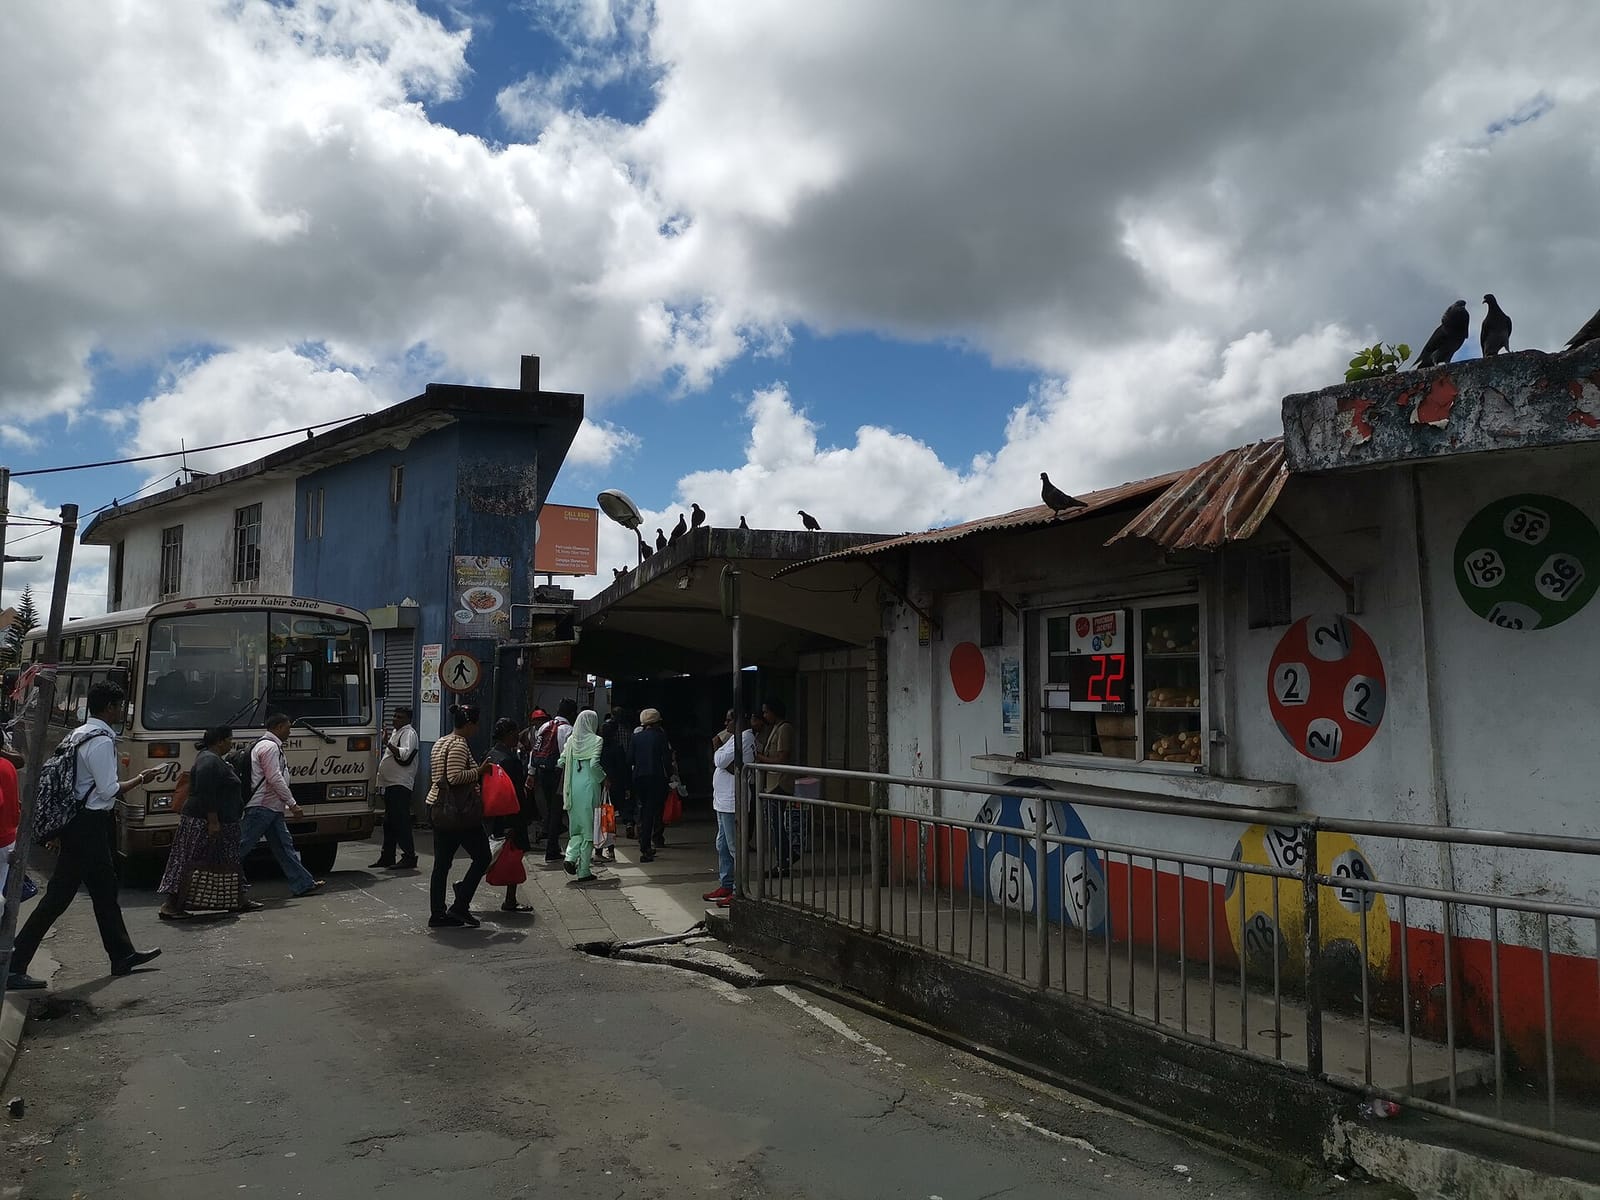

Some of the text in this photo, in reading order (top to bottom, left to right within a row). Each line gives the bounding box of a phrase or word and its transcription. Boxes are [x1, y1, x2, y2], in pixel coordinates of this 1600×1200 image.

[1510, 513, 1544, 541] 36
[1472, 551, 1503, 583] 36
[1540, 558, 1577, 593] 36
[214, 597, 320, 609] Satguru Kabir Saheb
[1314, 623, 1342, 646] 2
[1087, 654, 1126, 701] 22
[1283, 668, 1299, 699] 2
[1353, 682, 1371, 717] 2
[1308, 730, 1331, 748] 2
[320, 755, 365, 776] Tours
[1336, 858, 1369, 899] 28
